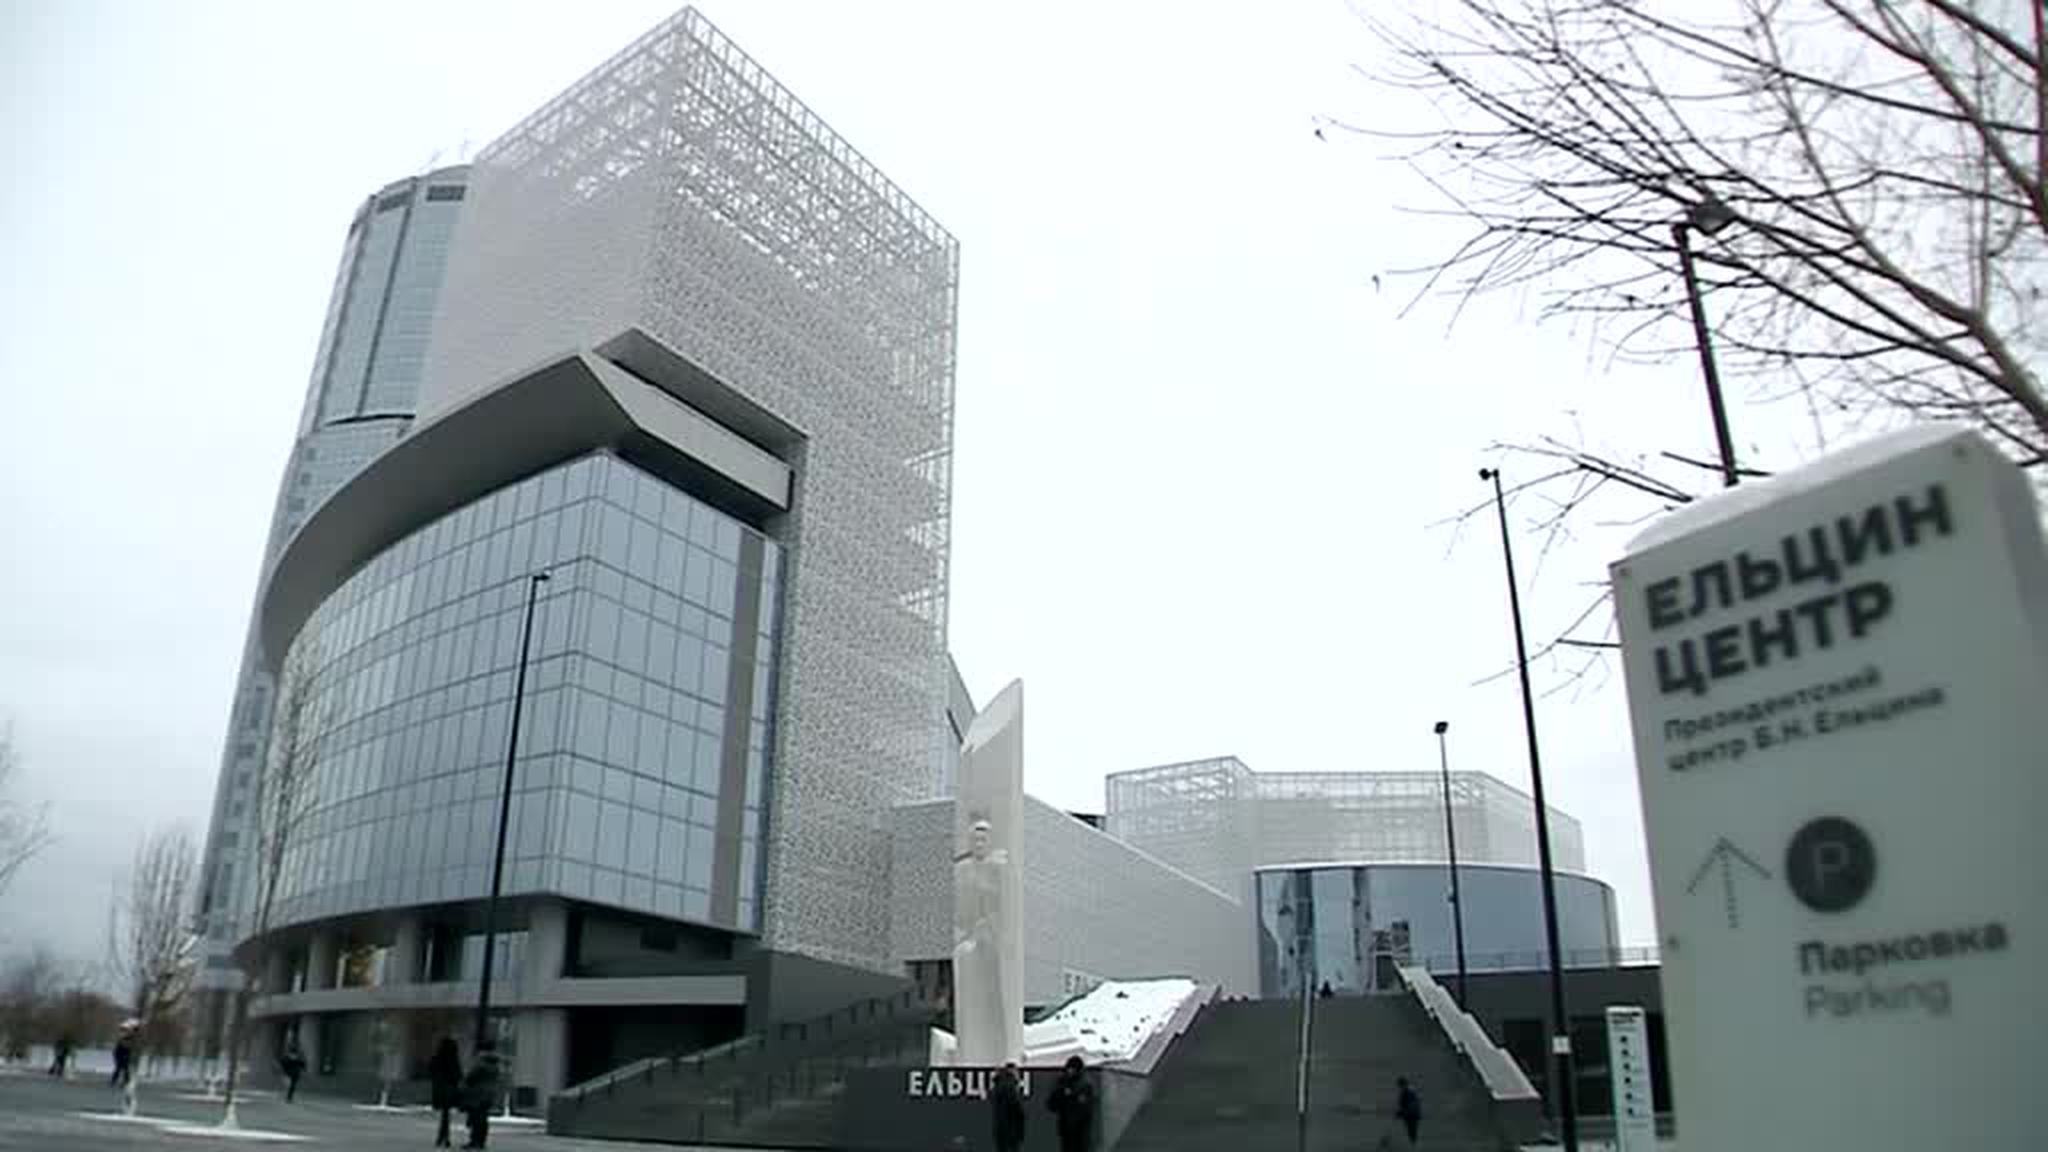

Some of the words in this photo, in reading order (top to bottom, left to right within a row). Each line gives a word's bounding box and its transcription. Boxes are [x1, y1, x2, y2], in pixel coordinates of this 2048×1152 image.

[1644, 483, 1953, 631] ЕЛЬЦИН
[1653, 580, 1893, 695] ЦЕНТР
[1664, 664, 1881, 741] Президентский
[1668, 738, 1747, 771] центр
[1815, 687, 1946, 734] Ельцина
[1814, 842, 1851, 894] P
[1799, 921, 2008, 976] Парковка
[1804, 979, 1952, 1018] Parking
